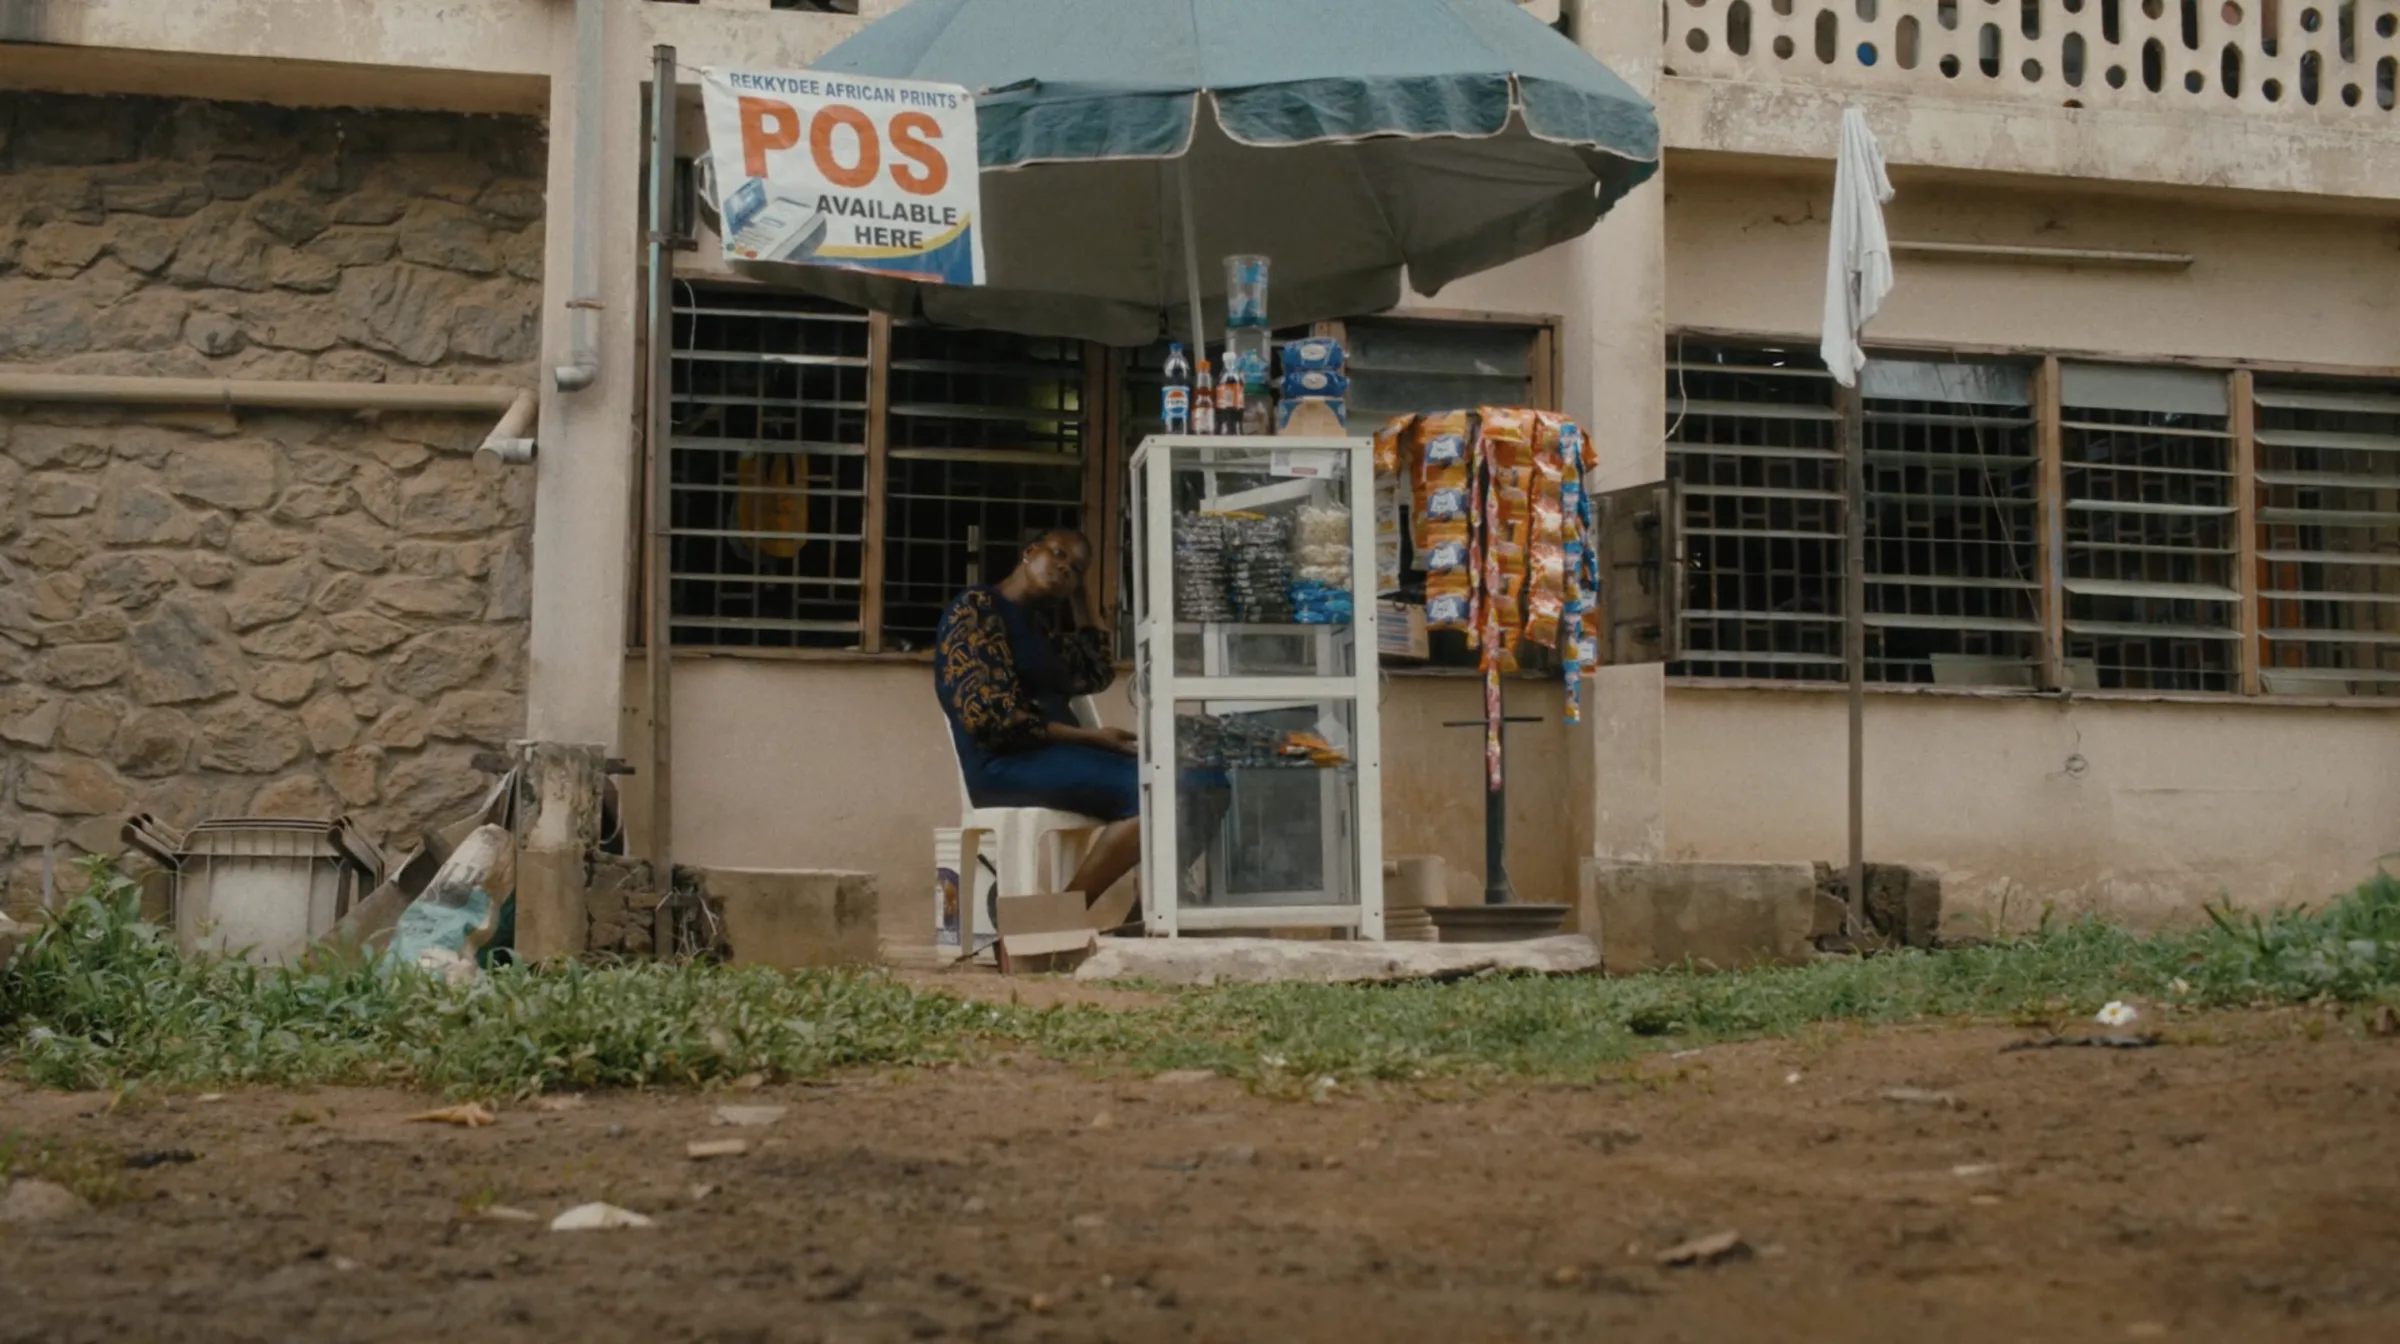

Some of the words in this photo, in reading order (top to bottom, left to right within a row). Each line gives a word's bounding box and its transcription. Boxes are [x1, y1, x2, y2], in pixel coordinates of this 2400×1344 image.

[730, 73, 820, 96] REKKYDEE
[825, 82, 896, 103] AFRICAN
[900, 90, 958, 109] PRINTS
[738, 96, 949, 195] POS
[816, 194, 958, 226] AVAILABLE
[855, 225, 924, 250] HERE
